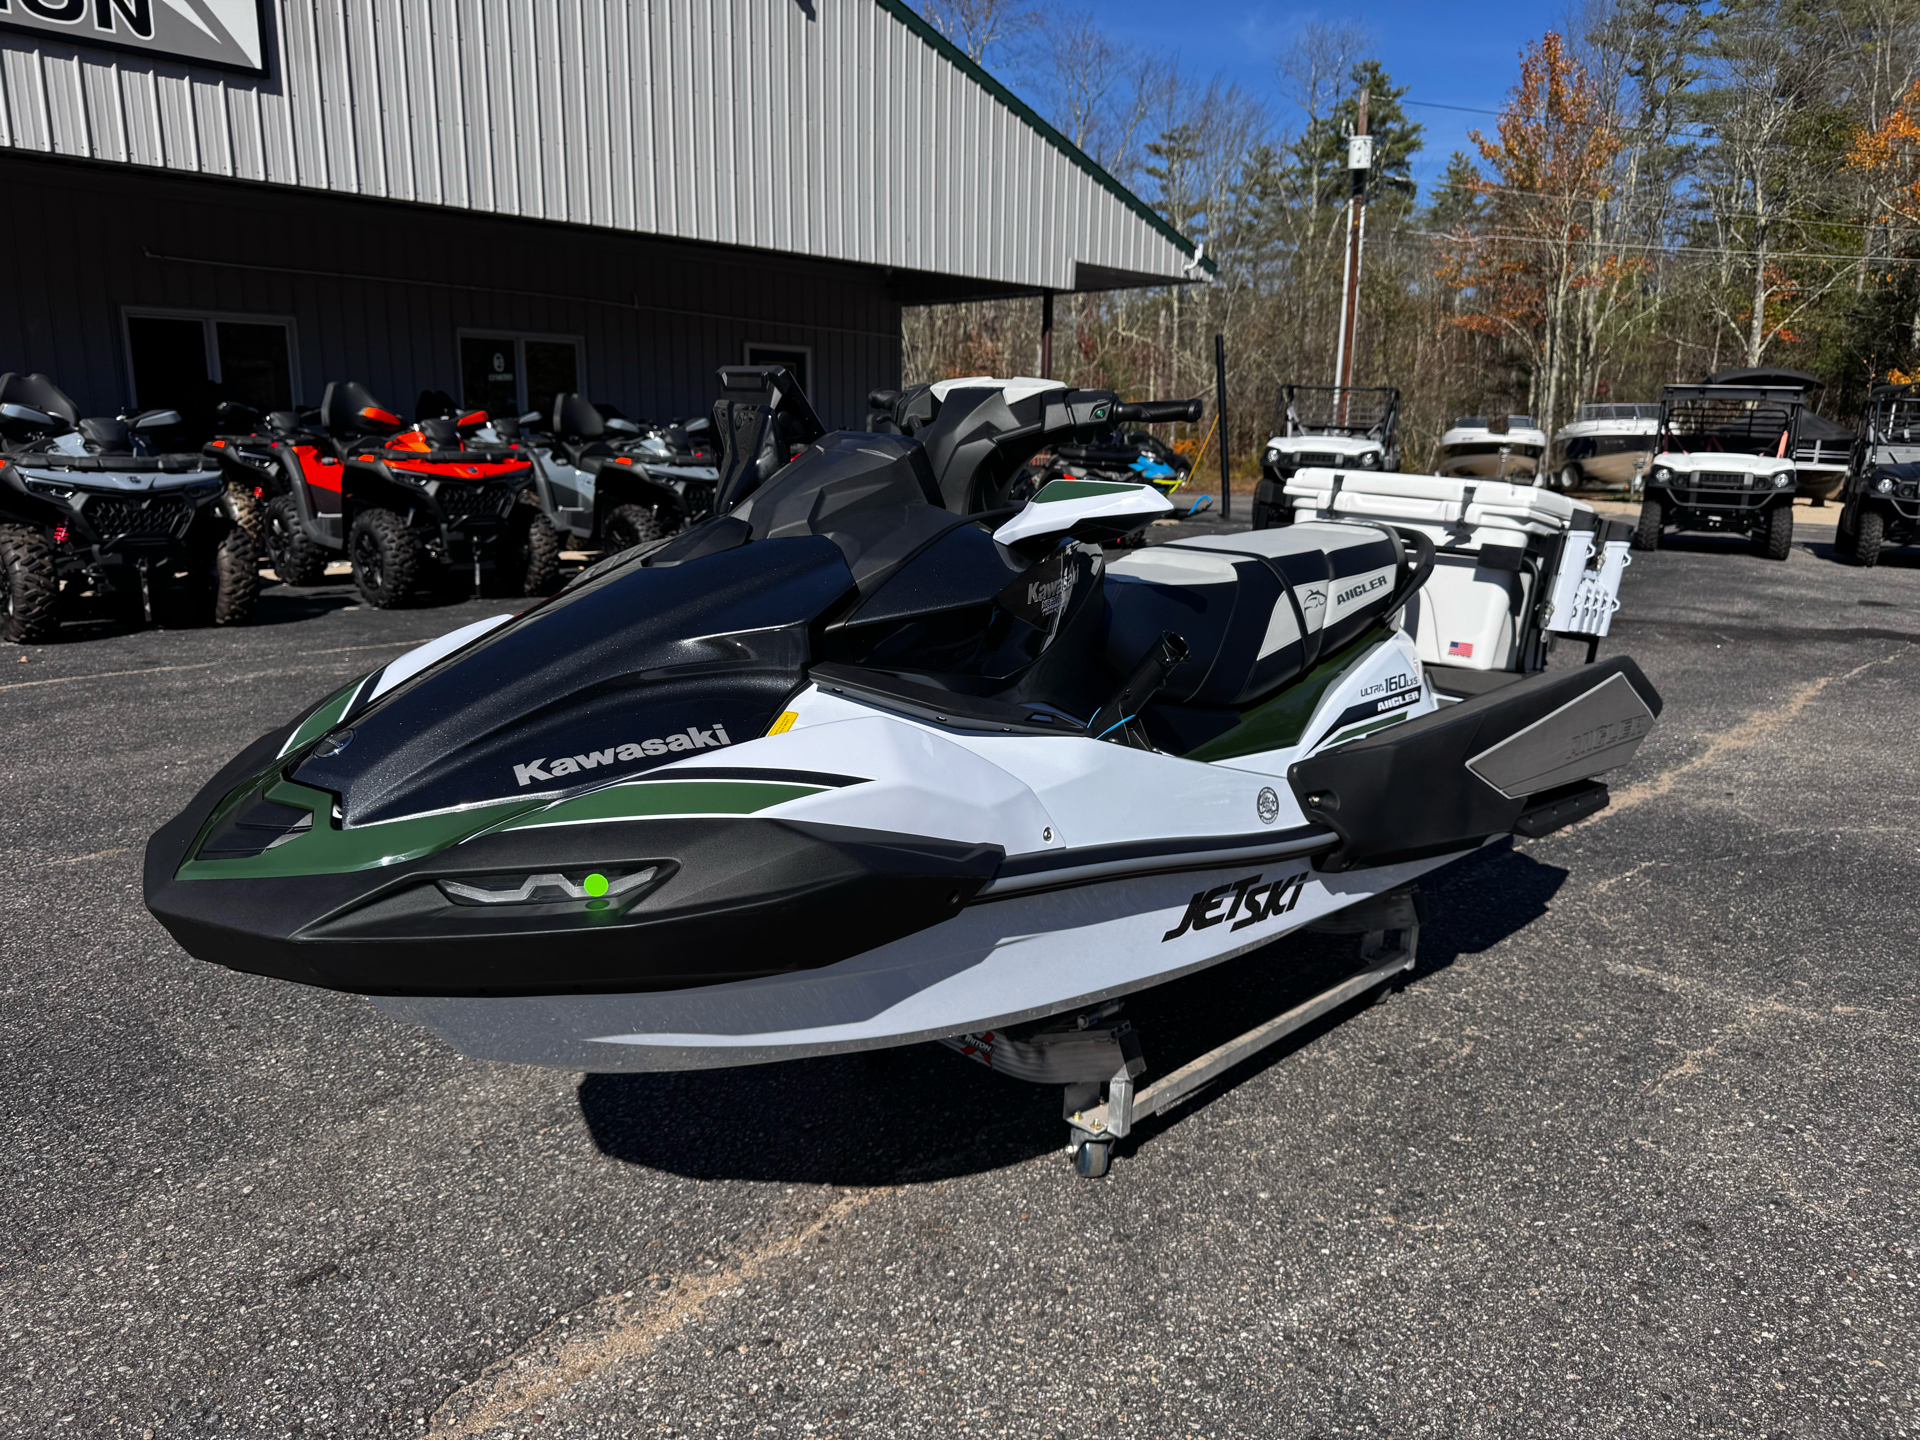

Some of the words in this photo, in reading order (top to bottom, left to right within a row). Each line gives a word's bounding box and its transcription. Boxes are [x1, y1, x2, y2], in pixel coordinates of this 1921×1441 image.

[1337, 575, 1388, 605] ANGLER
[1377, 690, 1420, 712] ANGLER
[512, 723, 732, 787] Kawasaki
